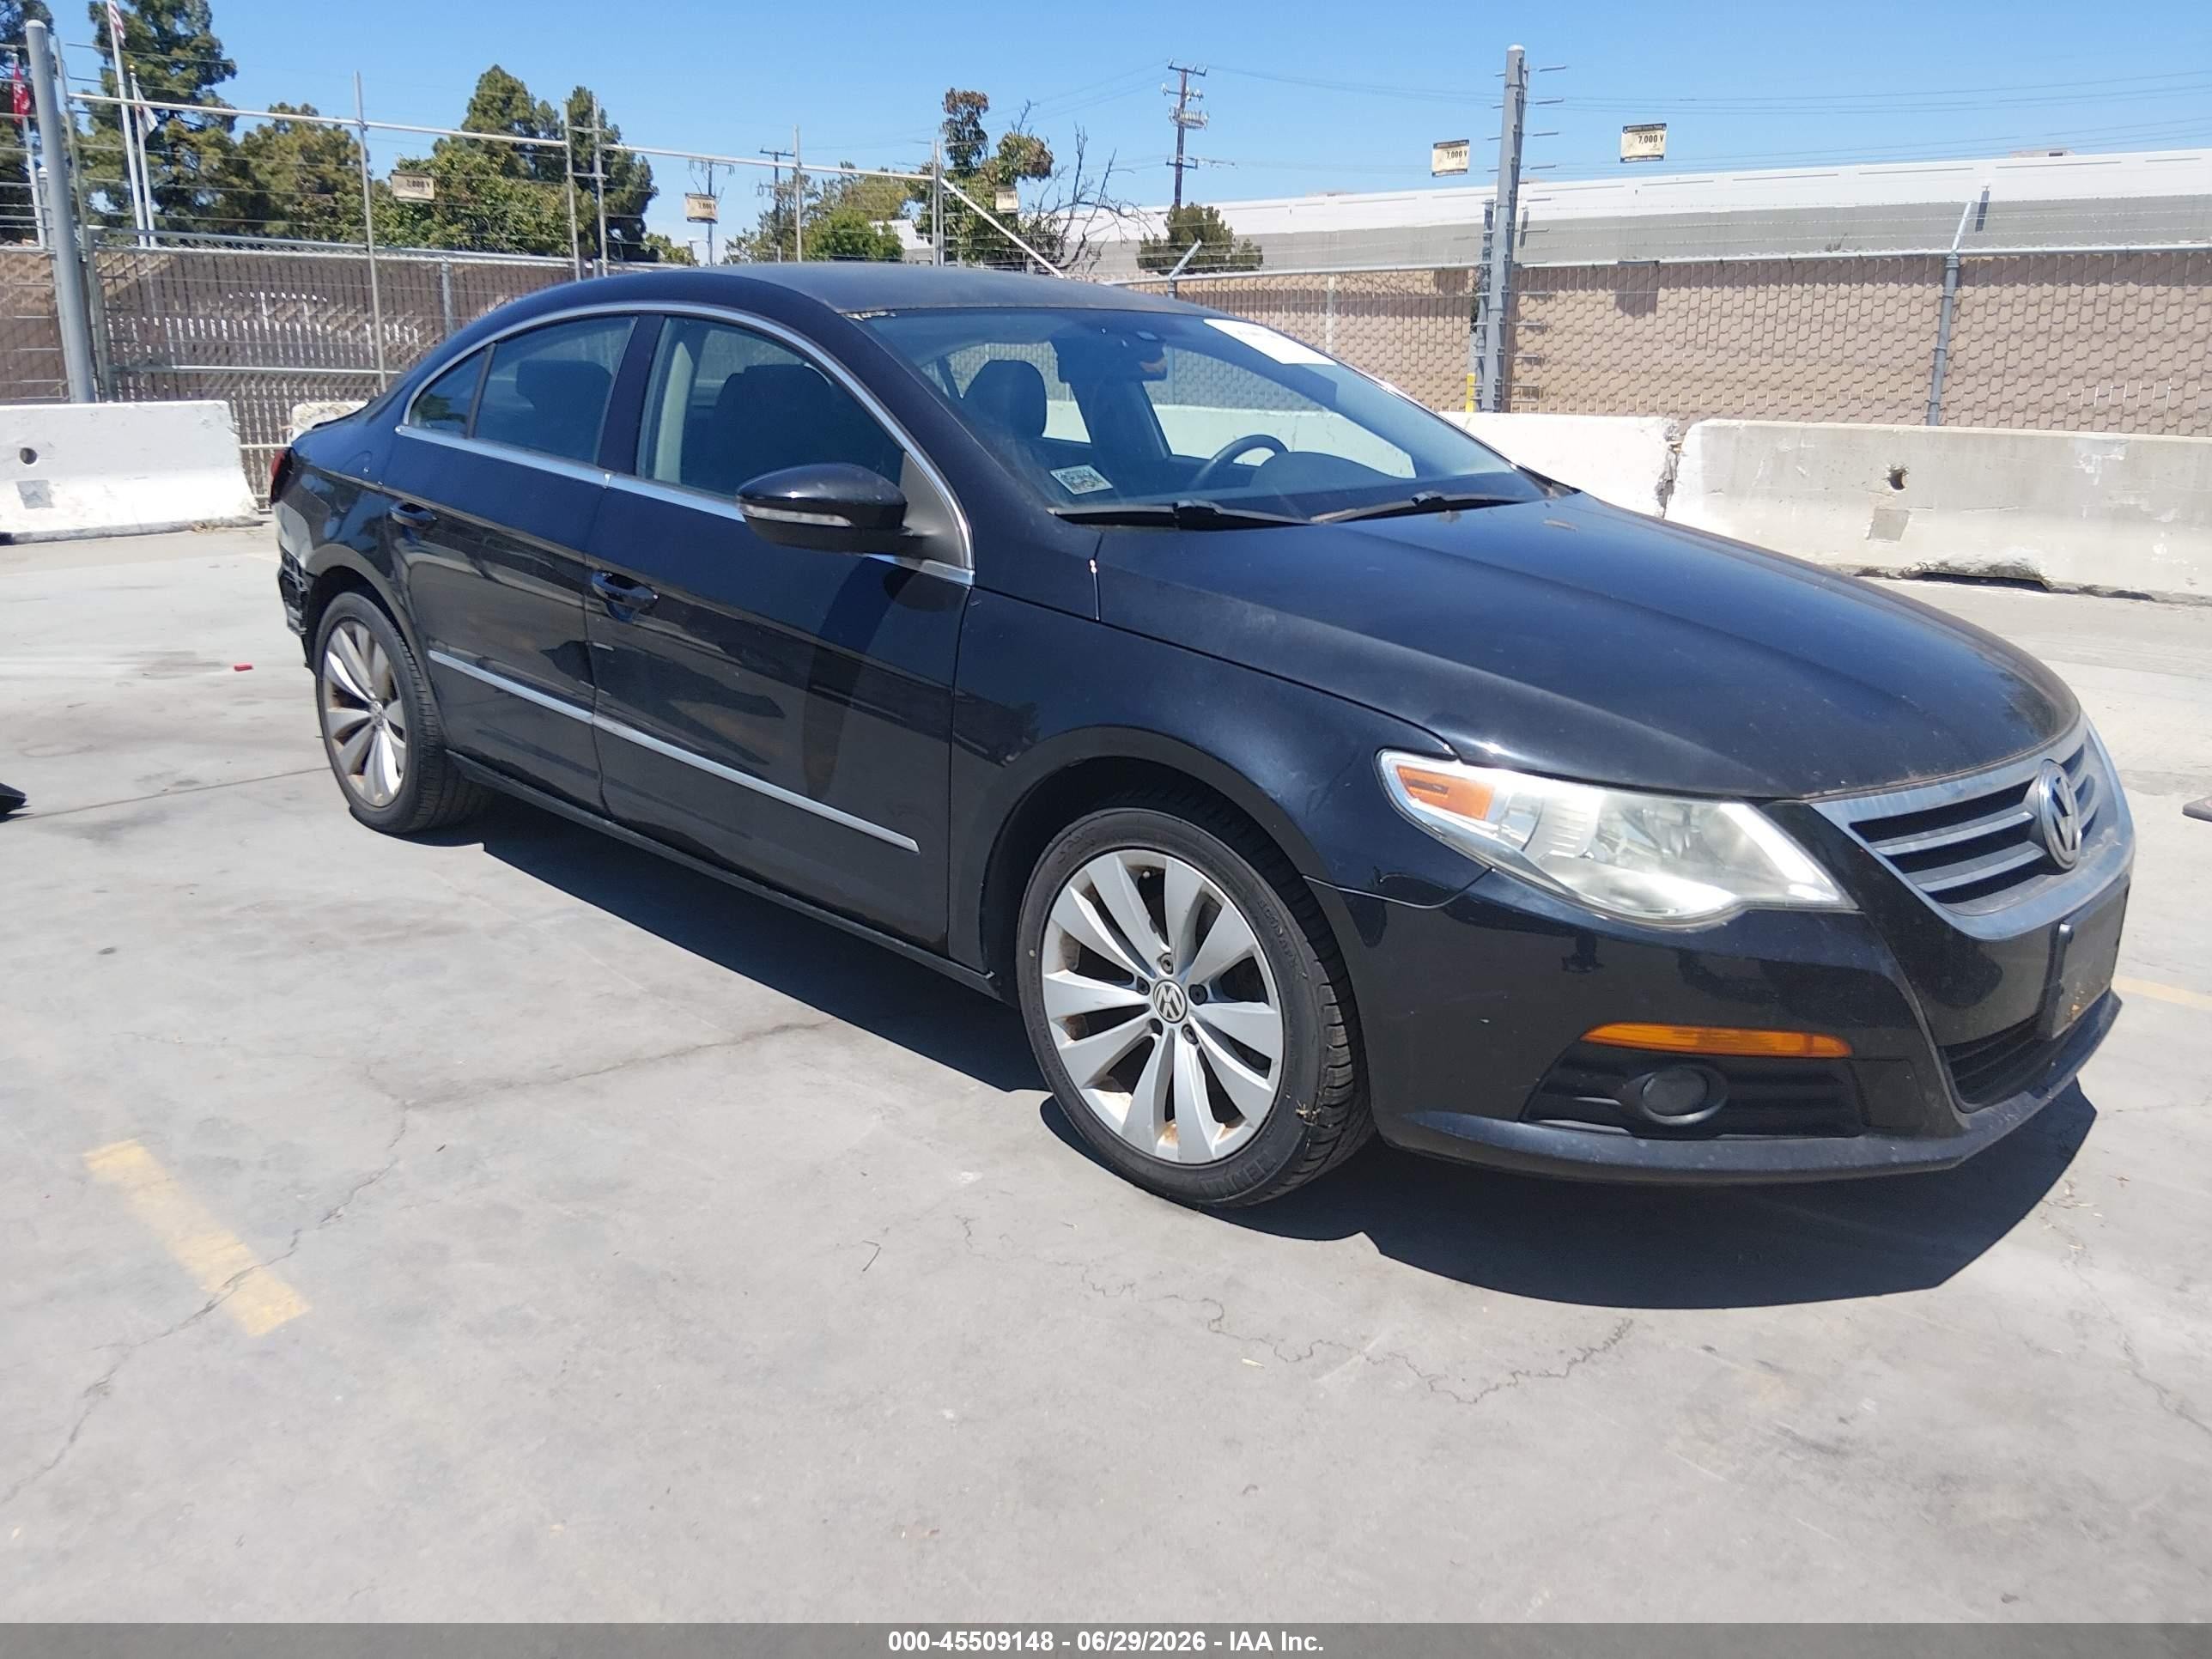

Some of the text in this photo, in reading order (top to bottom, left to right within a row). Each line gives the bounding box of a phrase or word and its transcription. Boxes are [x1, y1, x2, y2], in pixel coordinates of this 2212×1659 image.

[1638, 134, 1664, 144] 7,000 V
[1446, 150, 1463, 161] 7,000
